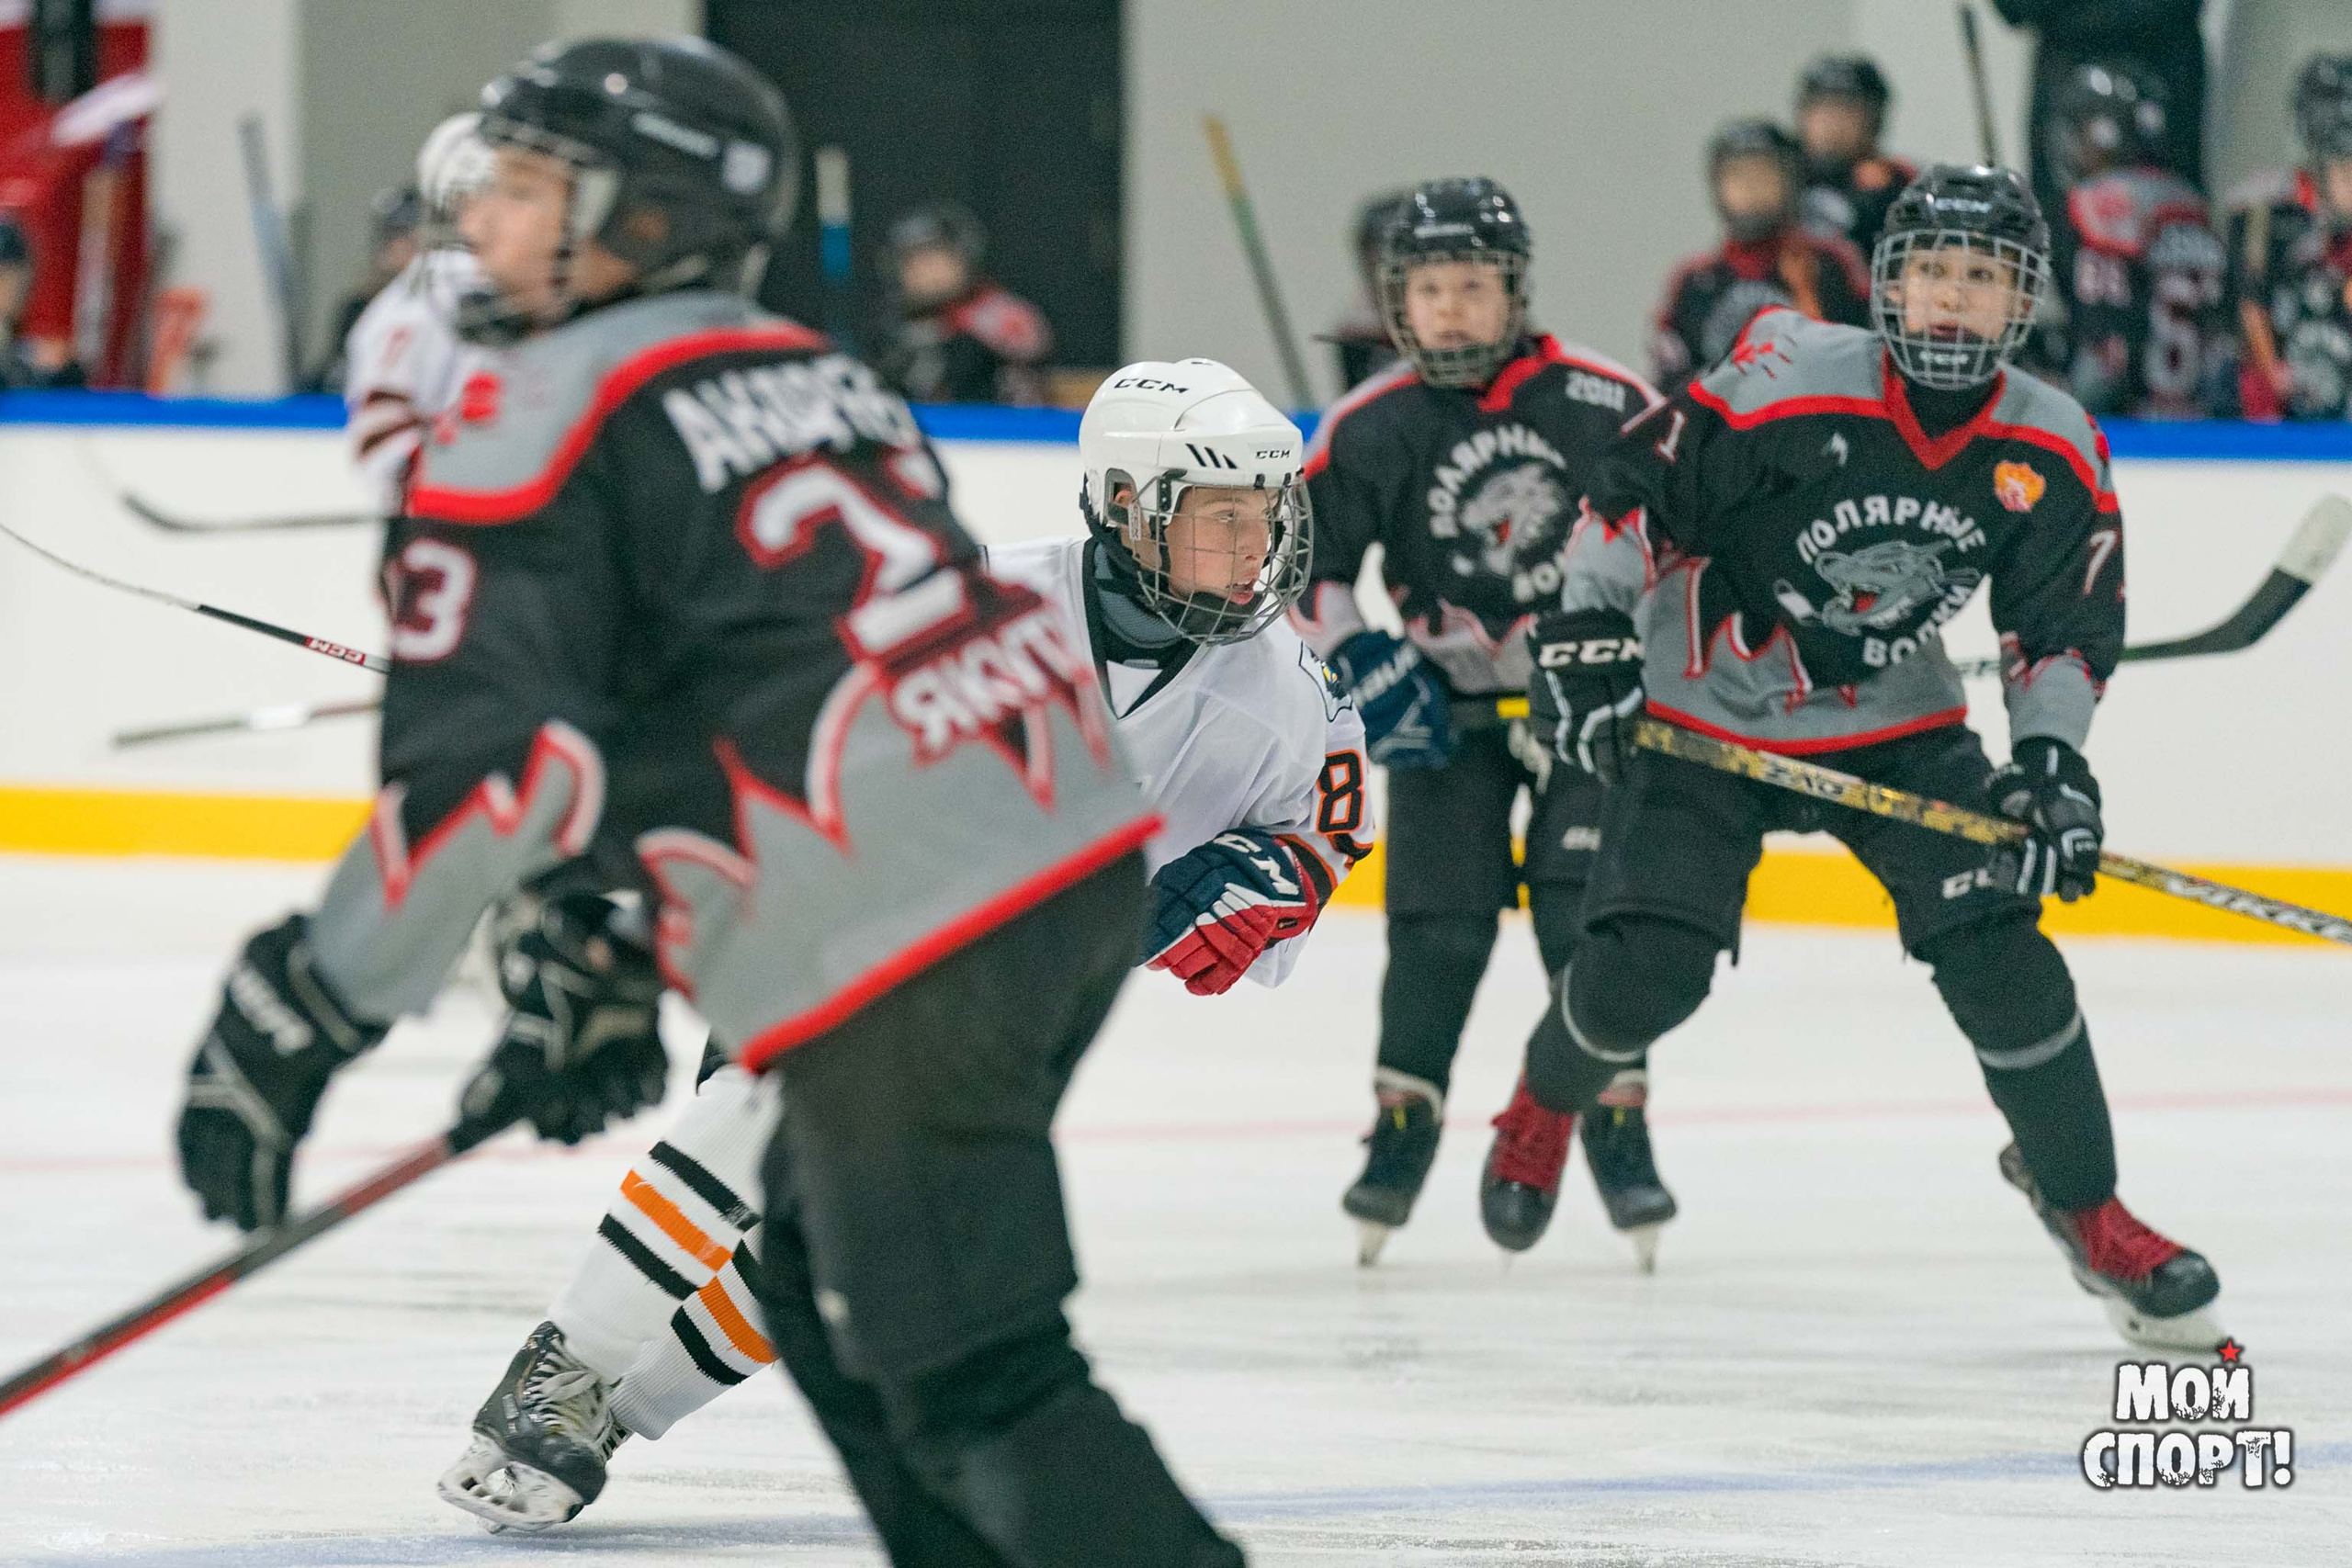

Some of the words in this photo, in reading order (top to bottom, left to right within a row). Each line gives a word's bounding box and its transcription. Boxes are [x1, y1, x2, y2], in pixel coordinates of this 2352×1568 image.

[1114, 378, 1190, 394] CCM
[1255, 449, 1292, 459] CCM
[737, 441, 974, 663] 2
[1796, 495, 1986, 565] ПОЛЯРНЫЕ
[2082, 526, 2124, 598] 7
[309, 637, 364, 664] CCM
[1213, 832, 1300, 896] CM
